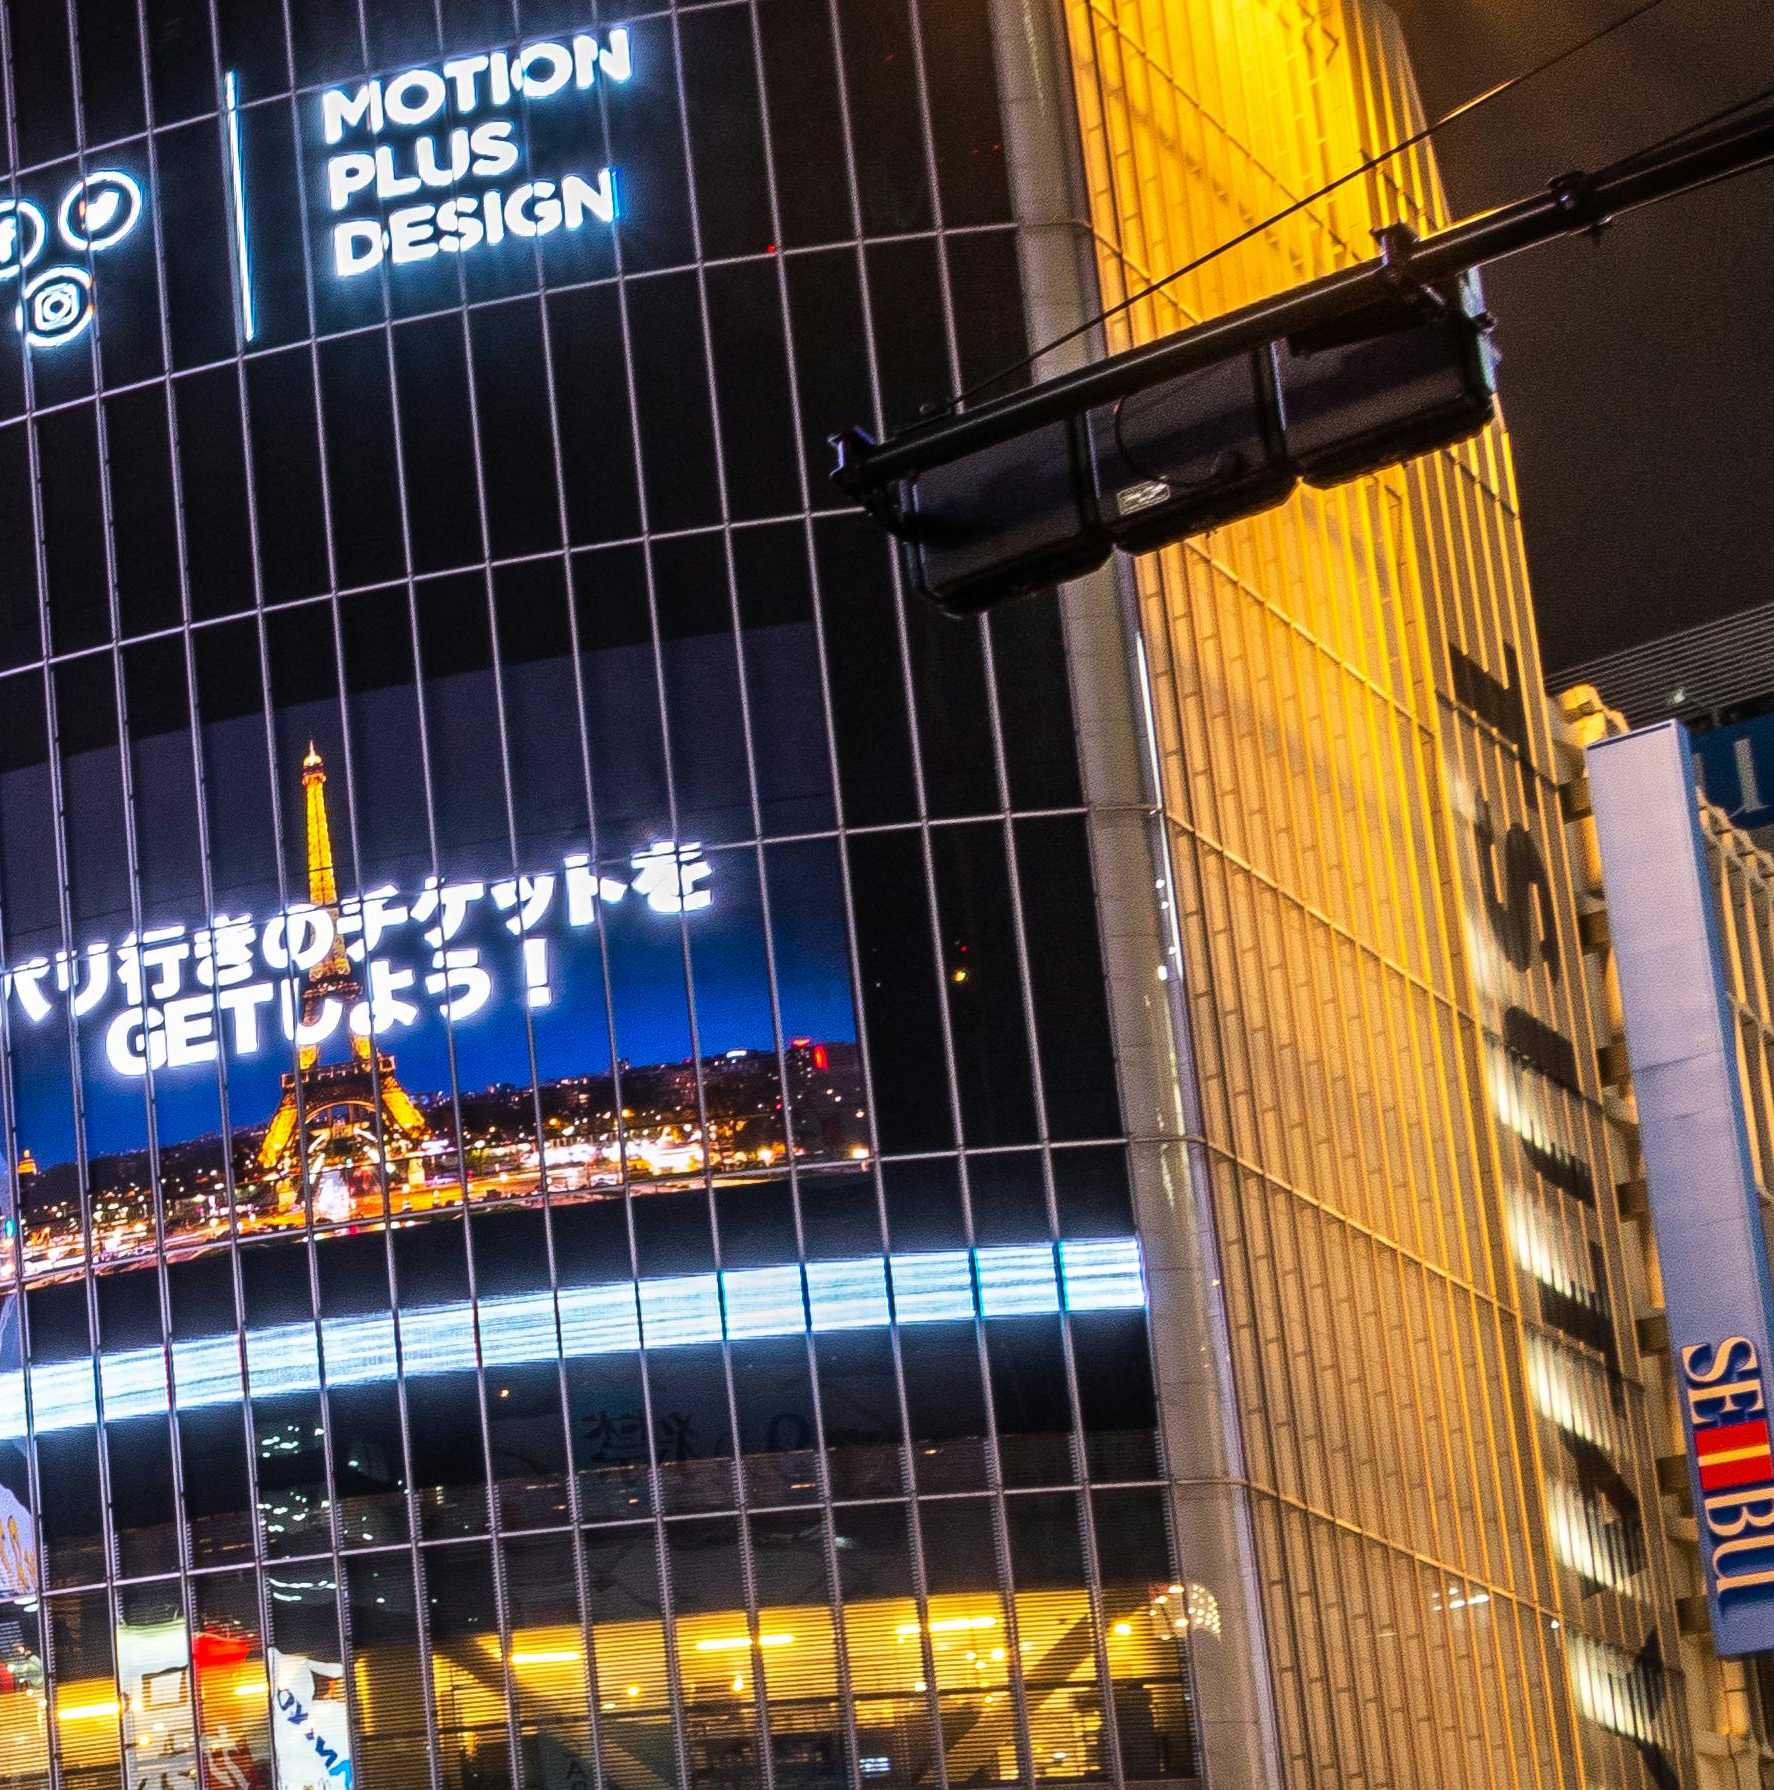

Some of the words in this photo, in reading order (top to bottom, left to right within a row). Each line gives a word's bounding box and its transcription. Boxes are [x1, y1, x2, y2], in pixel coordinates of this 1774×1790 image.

[323, 27, 633, 144] MOTION
[328, 121, 519, 211] PLUS
[334, 168, 624, 277] DESIGN
